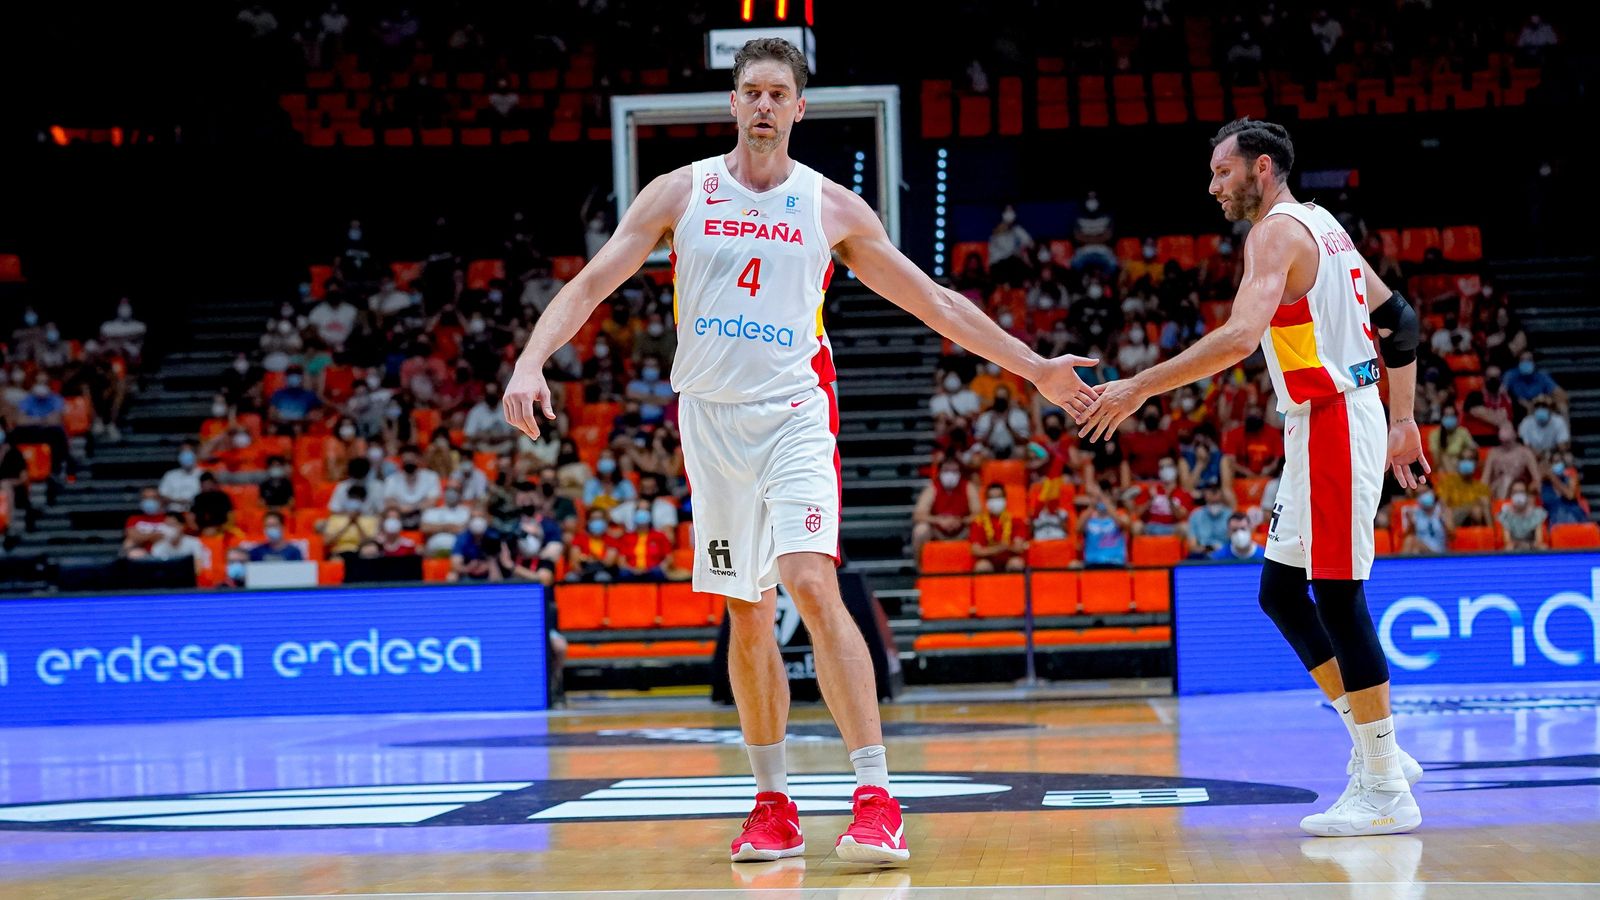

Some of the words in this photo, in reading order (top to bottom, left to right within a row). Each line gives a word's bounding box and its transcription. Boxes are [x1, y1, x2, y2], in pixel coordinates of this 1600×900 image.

[704, 219, 804, 246] ESPAÑA
[737, 257, 762, 297] 4
[1350, 268, 1374, 341] 5
[694, 314, 794, 347] endesa
[35, 634, 243, 686] endesa
[272, 627, 482, 678] endesa
